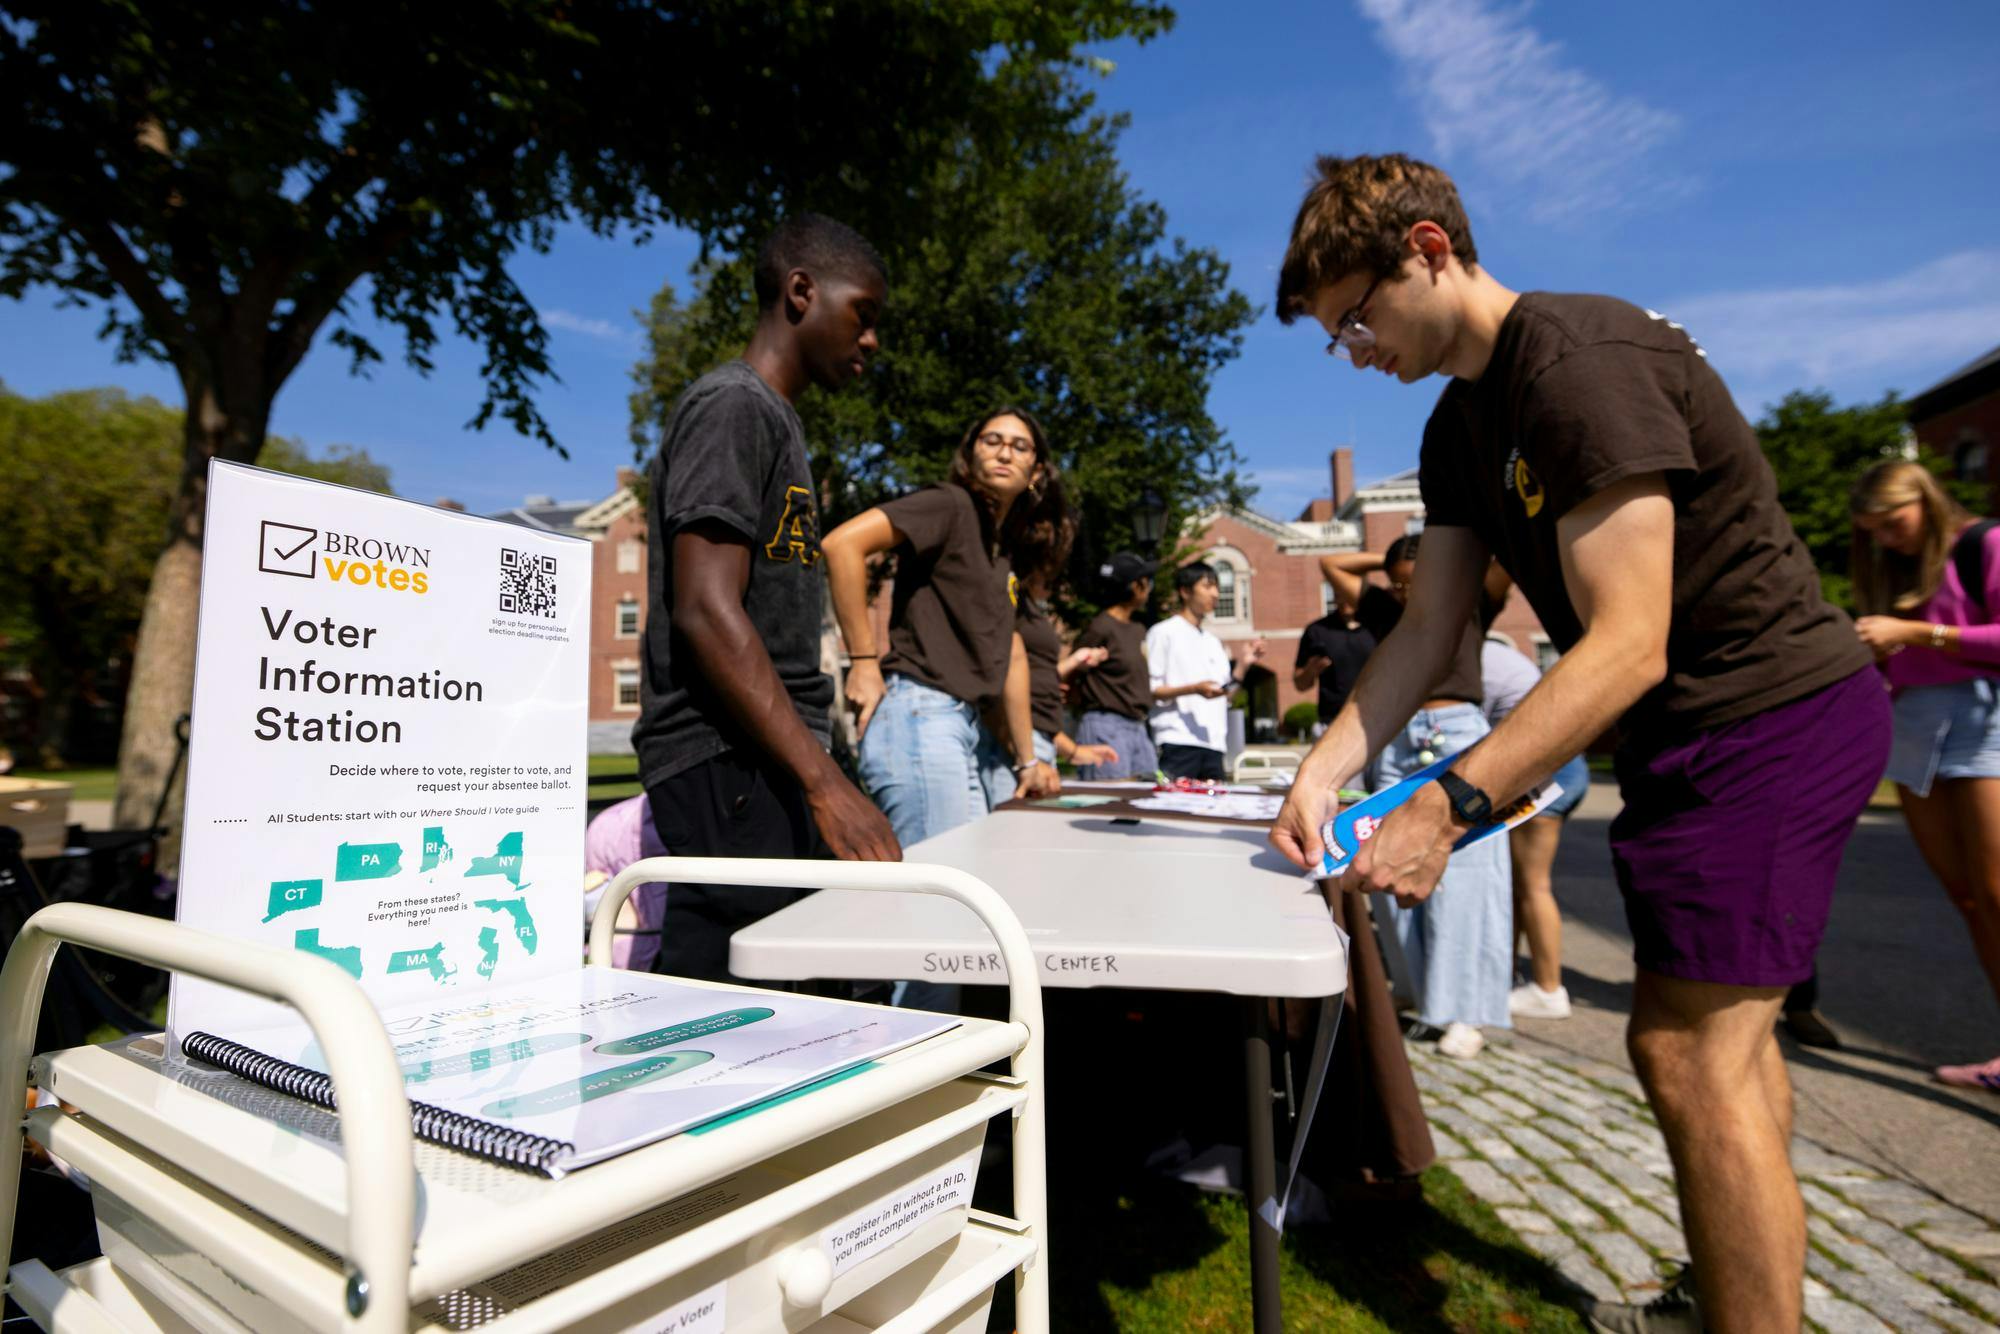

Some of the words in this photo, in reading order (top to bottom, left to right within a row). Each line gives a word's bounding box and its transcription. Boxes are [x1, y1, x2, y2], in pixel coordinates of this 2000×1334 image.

[765, 485, 822, 565] A
[324, 531, 431, 569] BROWN
[324, 558, 429, 594] votes
[260, 606, 376, 649] Voter
[488, 627, 516, 636] election
[517, 631, 544, 639] deadline
[493, 618, 506, 626] sign
[528, 623, 567, 633] personalized
[258, 656, 483, 702] Information
[254, 706, 401, 743] Station
[330, 764, 376, 776] Decide
[380, 765, 419, 776] where
[422, 765, 434, 775] to
[437, 766, 466, 776] vote,
[469, 764, 511, 777] register
[513, 764, 524, 775] to
[527, 765, 551, 776] vote,
[554, 764, 572, 775] and
[416, 783, 461, 794] request
[464, 783, 489, 793] your
[491, 780, 539, 791] absentee
[541, 779, 571, 791] ballot.
[267, 814, 284, 824] All
[286, 811, 343, 823] Students:
[345, 811, 371, 821] start
[373, 810, 397, 819] with
[420, 808, 453, 818] Where
[454, 805, 487, 816] Should
[494, 806, 514, 815] Vote
[515, 804, 540, 814] guide
[425, 842, 438, 853] RI
[361, 854, 380, 866] PA
[498, 856, 516, 867] NY
[284, 887, 307, 901] CT
[377, 900, 402, 910] From
[404, 897, 429, 907] these
[430, 892, 461, 904] states?
[367, 908, 418, 922] Everything
[420, 907, 437, 917] you
[438, 903, 459, 914] need
[461, 902, 468, 911] is
[407, 917, 431, 928] here!
[519, 926, 533, 937] FL
[406, 953, 429, 967] MA
[480, 961, 494, 971] NJ
[923, 951, 1001, 974] SWEAR
[1045, 953, 1119, 974] CENTER
[691, 1014, 737, 1029] choose
[585, 1080, 610, 1091] do
[622, 1061, 670, 1078] vote?
[832, 1236, 843, 1249] To
[845, 1216, 880, 1241] register
[883, 1210, 890, 1221] in
[893, 1203, 901, 1215] RI
[903, 1186, 934, 1209] without
[936, 1183, 941, 1192] a
[943, 1177, 952, 1189] RI
[954, 1172, 966, 1183] ID,
[835, 1248, 852, 1265] you
[855, 1233, 877, 1252] must
[880, 1208, 918, 1238] complete
[920, 1200, 935, 1214] this
[937, 1190, 959, 1206] form.
[680, 1302, 715, 1327] Voter
